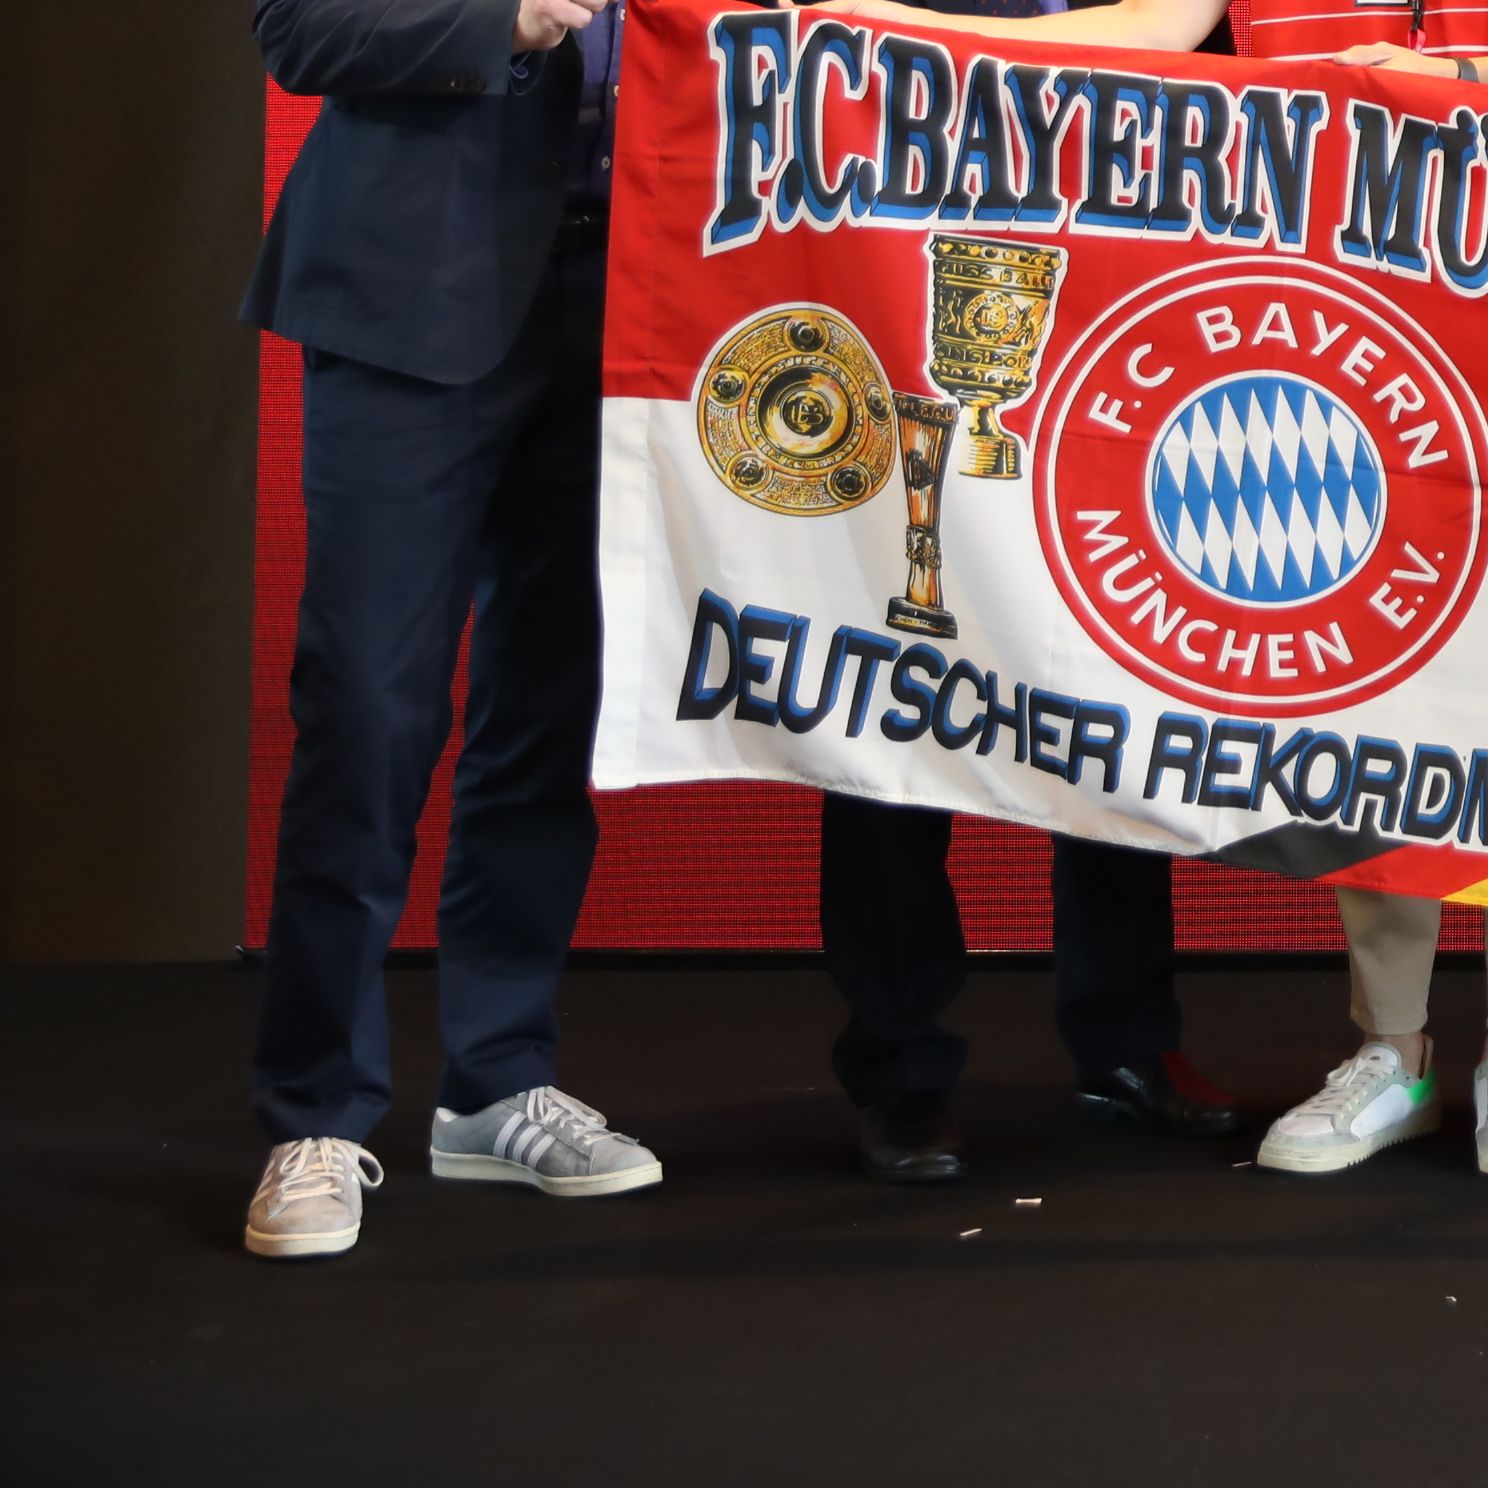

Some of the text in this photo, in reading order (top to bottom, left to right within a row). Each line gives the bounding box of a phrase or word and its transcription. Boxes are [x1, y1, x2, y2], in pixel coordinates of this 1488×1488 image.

[1196, 302, 1448, 469] BAYERN
[1076, 509, 1447, 678] MÜNCHEN E.V.
[675, 589, 1132, 794] DEUTSCHER
